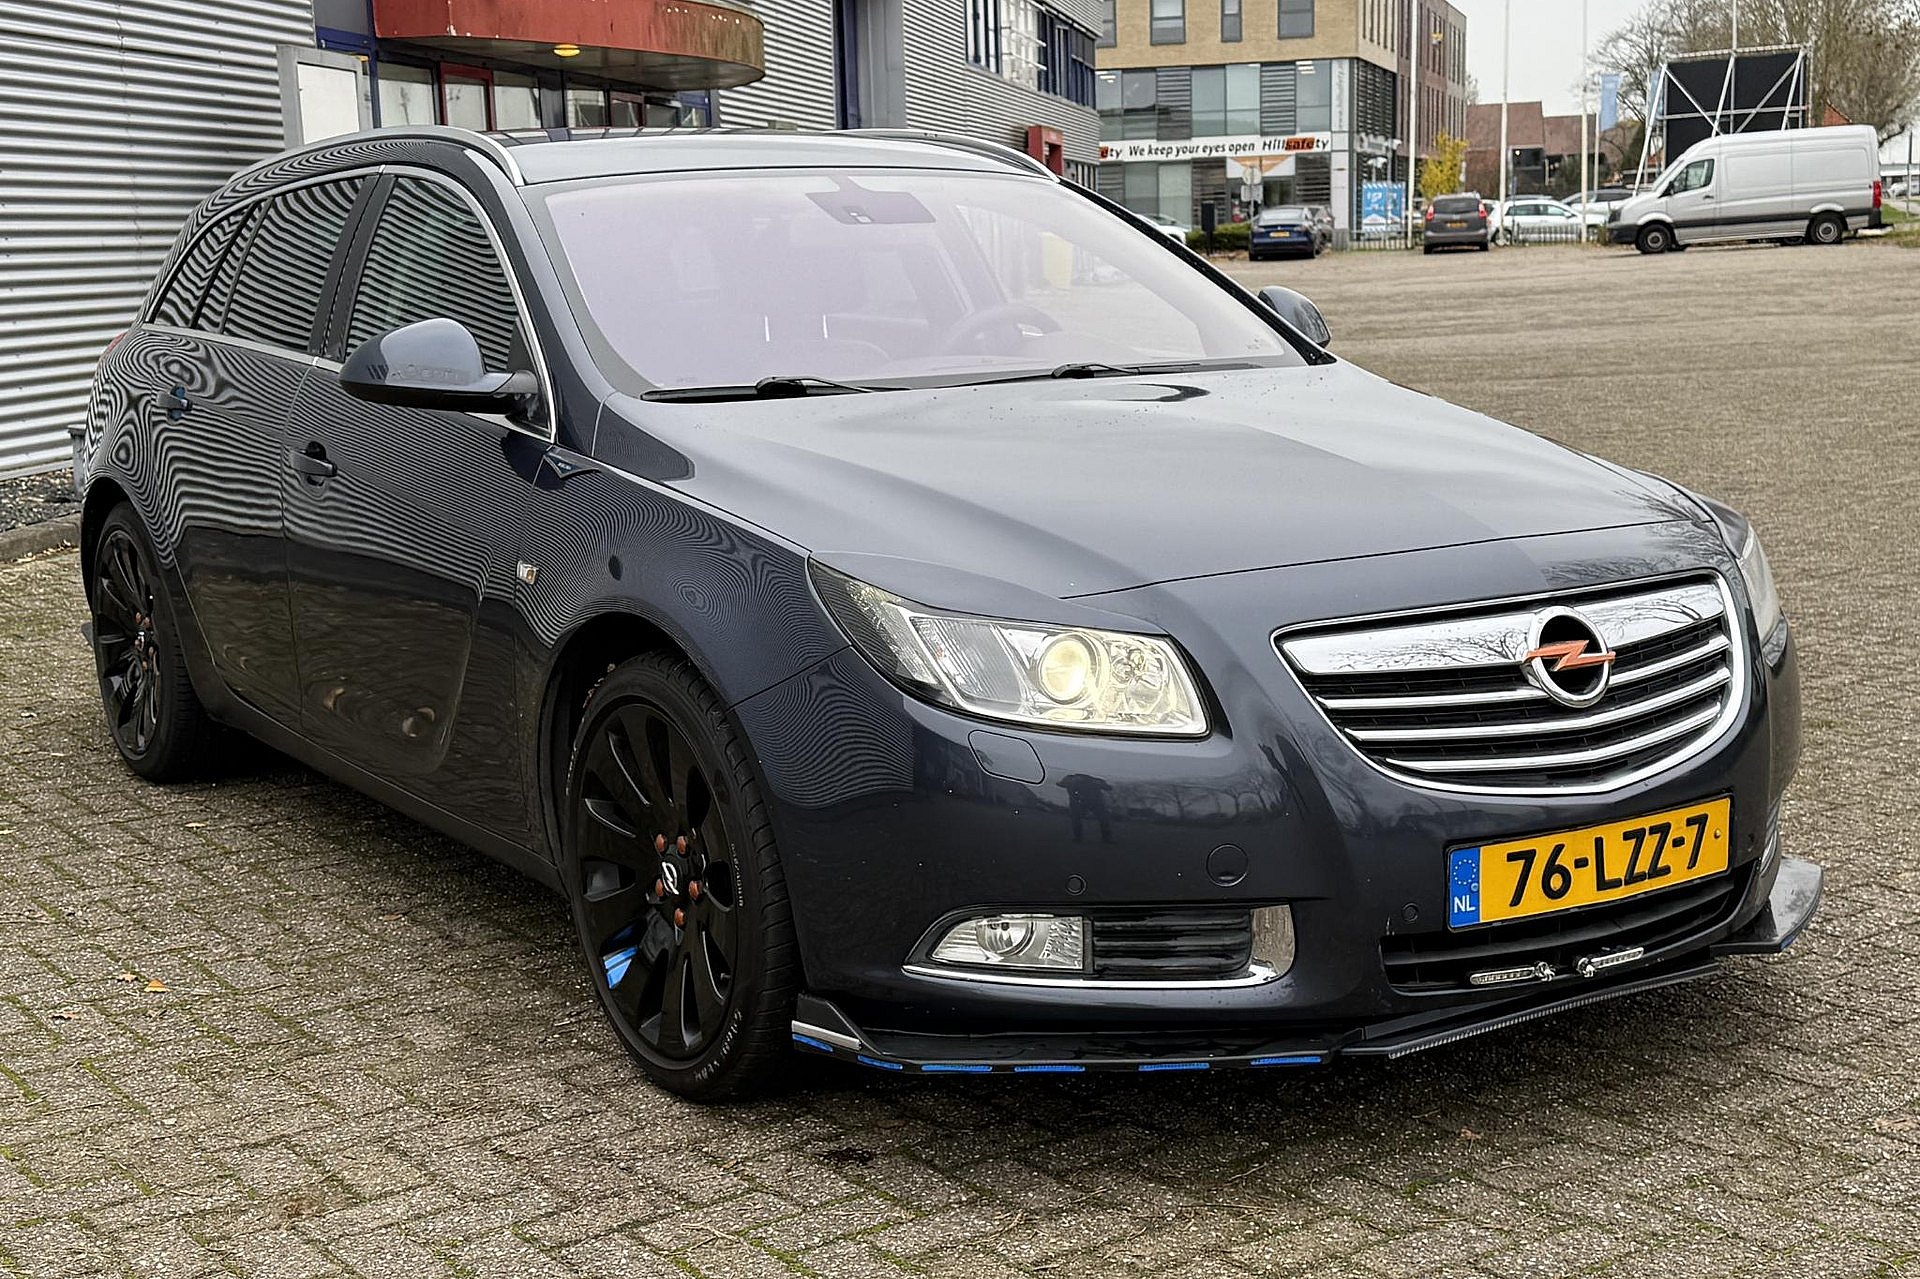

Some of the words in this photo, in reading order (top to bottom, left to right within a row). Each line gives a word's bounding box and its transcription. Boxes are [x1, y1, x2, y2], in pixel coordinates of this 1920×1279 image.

[1129, 146, 1145, 156] We
[1147, 144, 1173, 157] keep
[1175, 145, 1200, 157] your
[1202, 143, 1226, 156] eyes
[1228, 142, 1255, 154] open
[1262, 137, 1329, 151] Hillsafety
[1506, 813, 1709, 907] 76-LZZ-7
[1453, 896, 1476, 913] NL
